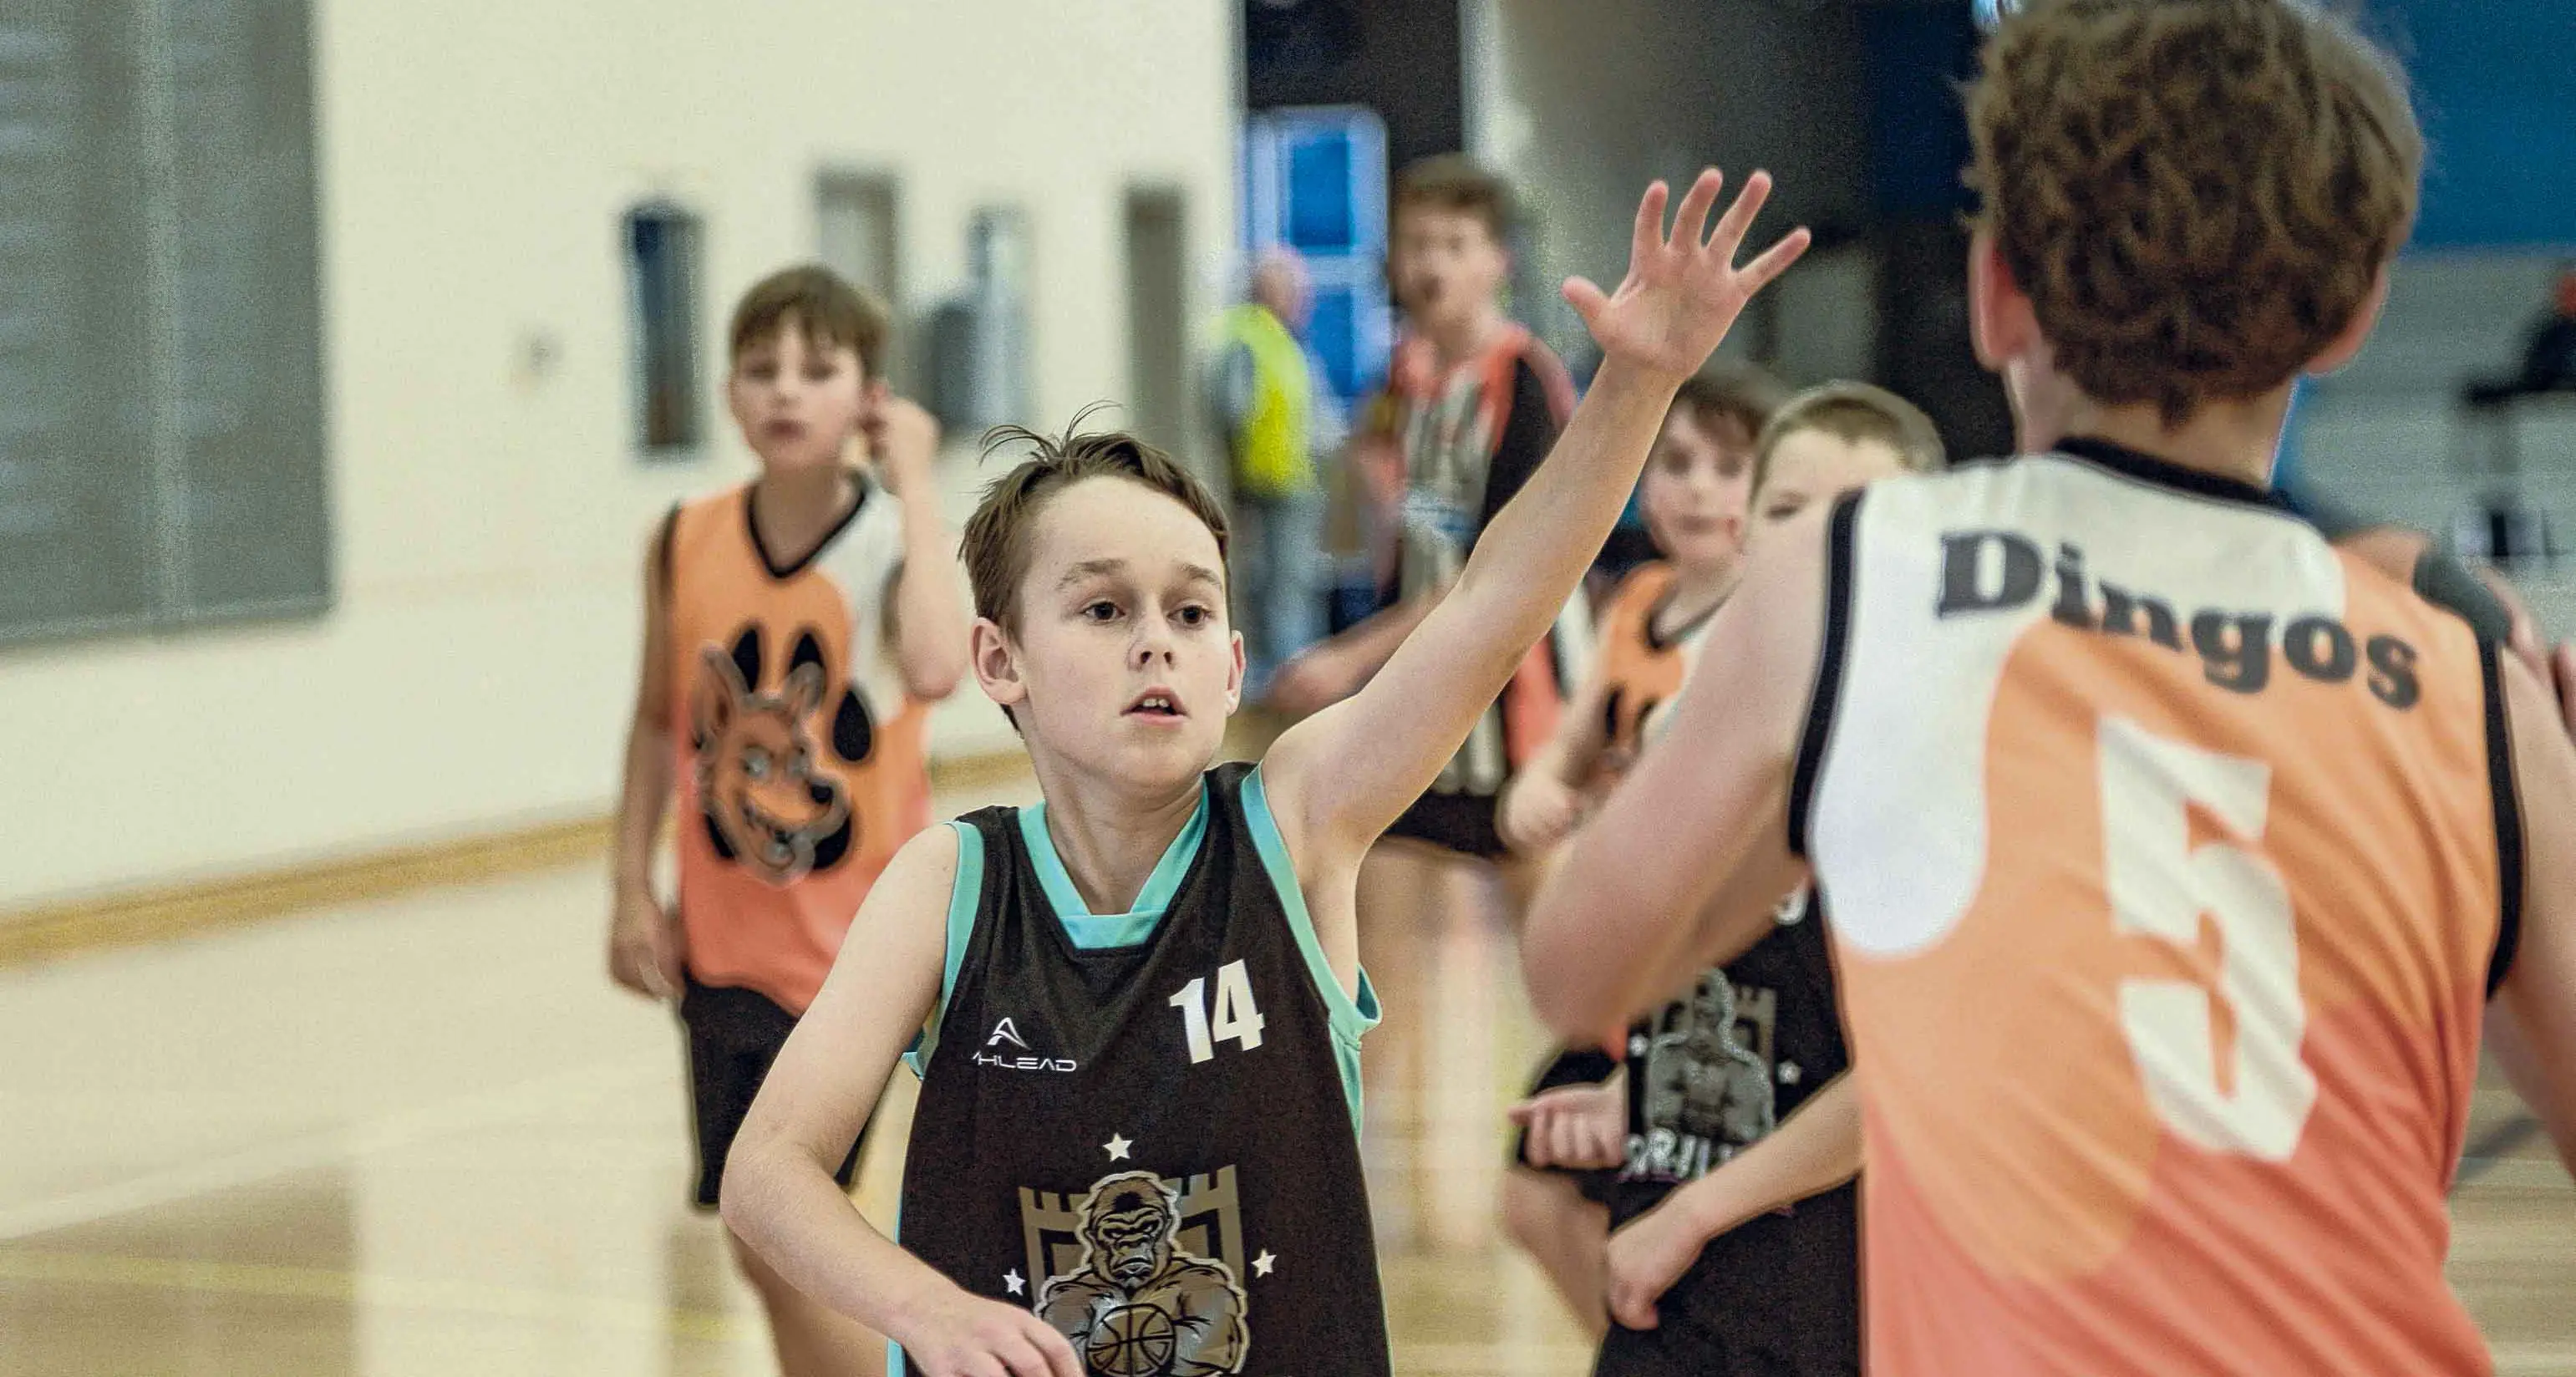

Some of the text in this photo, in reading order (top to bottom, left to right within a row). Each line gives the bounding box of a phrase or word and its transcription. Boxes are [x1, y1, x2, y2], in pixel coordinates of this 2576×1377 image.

[1935, 530, 2420, 709] Dingos
[1170, 958, 1266, 1065] 14
[2096, 712, 2318, 1161] 5
